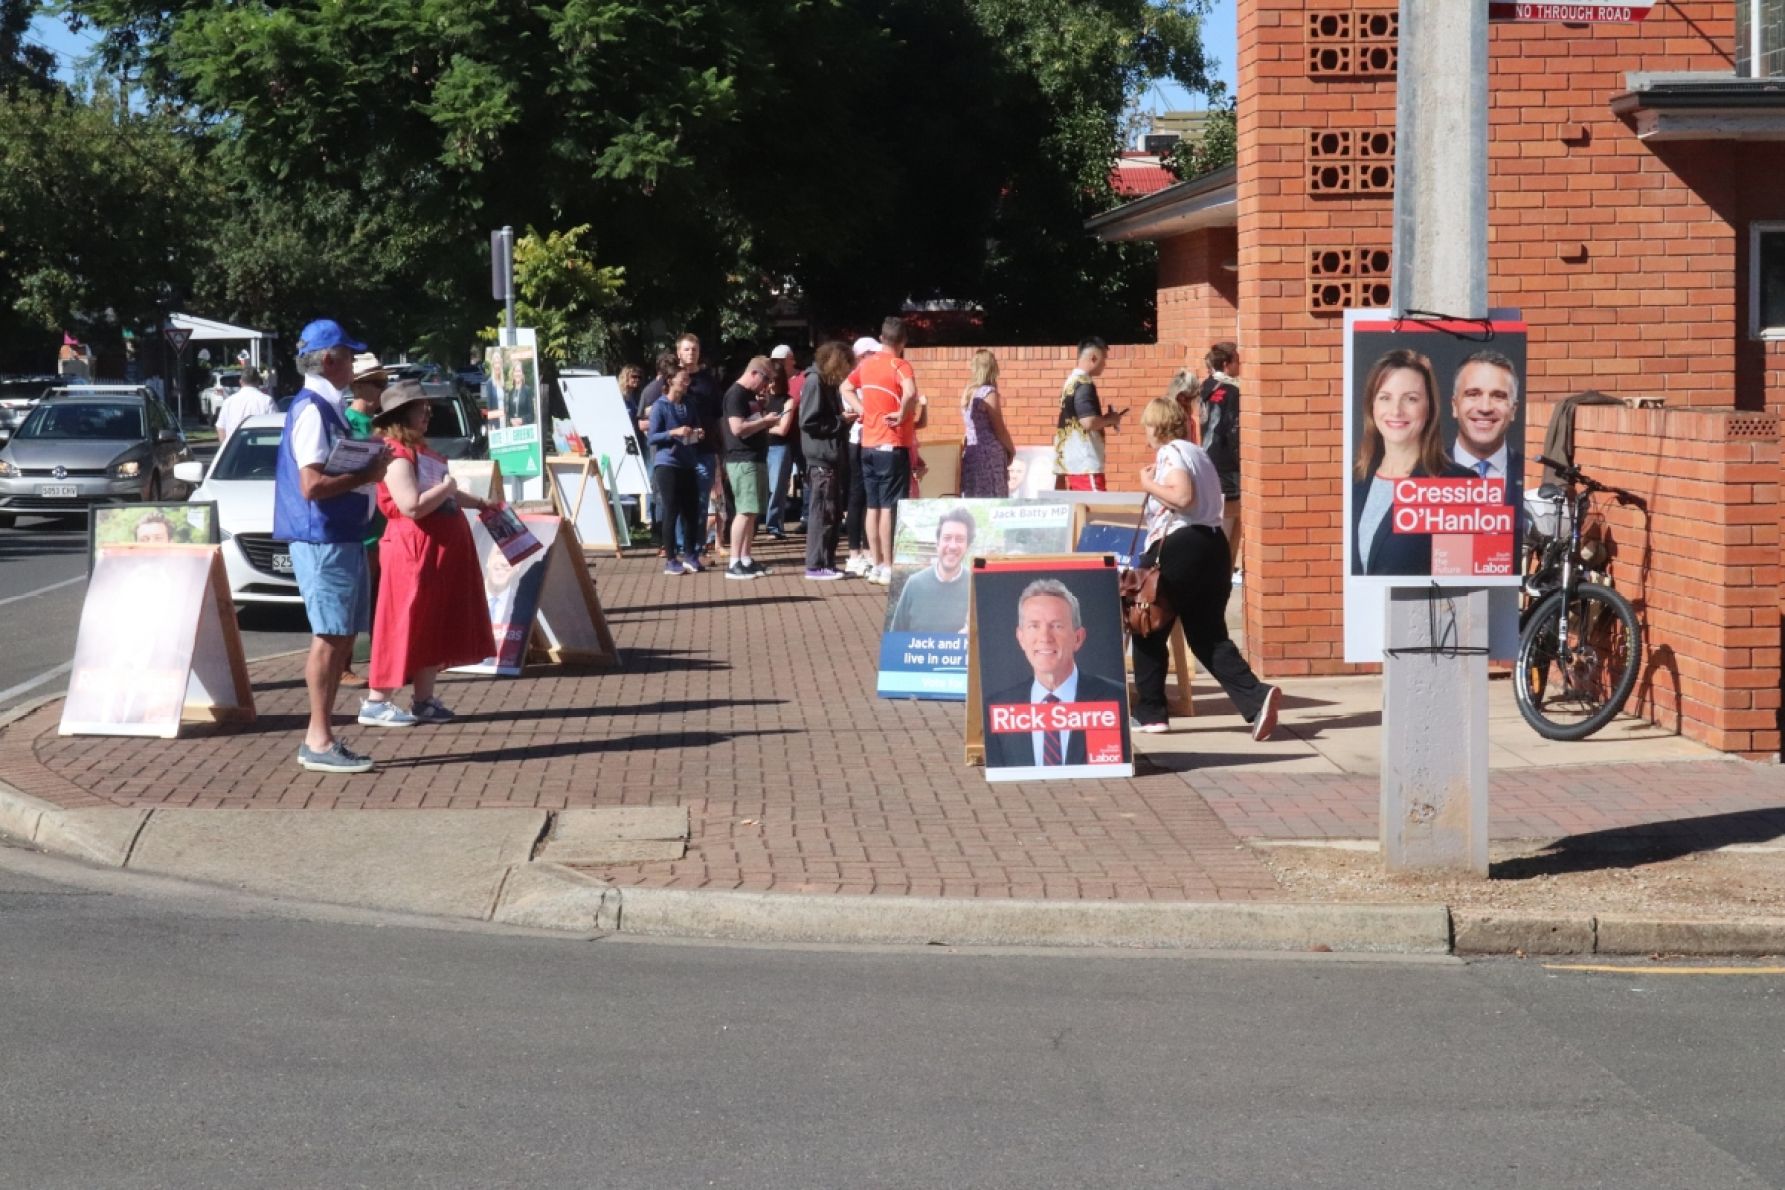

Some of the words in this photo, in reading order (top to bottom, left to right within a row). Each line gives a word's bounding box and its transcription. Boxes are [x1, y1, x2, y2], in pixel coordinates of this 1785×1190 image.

[1515, 5, 1532, 18] NO
[1537, 6, 1594, 20] THROUGH
[1598, 7, 1631, 21] ROAD
[1396, 480, 1502, 504] Cressida
[993, 508, 1016, 519] Jack
[1019, 507, 1048, 519] Batty
[1051, 506, 1068, 517] MP
[1396, 507, 1511, 532] O’Hanlon
[1474, 562, 1511, 574] Labor
[908, 637, 935, 649] Jack
[938, 638, 961, 650] and
[904, 652, 925, 664] live
[928, 652, 938, 664] in
[942, 655, 962, 666] our
[993, 706, 1046, 730] Rick
[1051, 705, 1116, 729] Sarre
[1088, 752, 1121, 763] Labor
